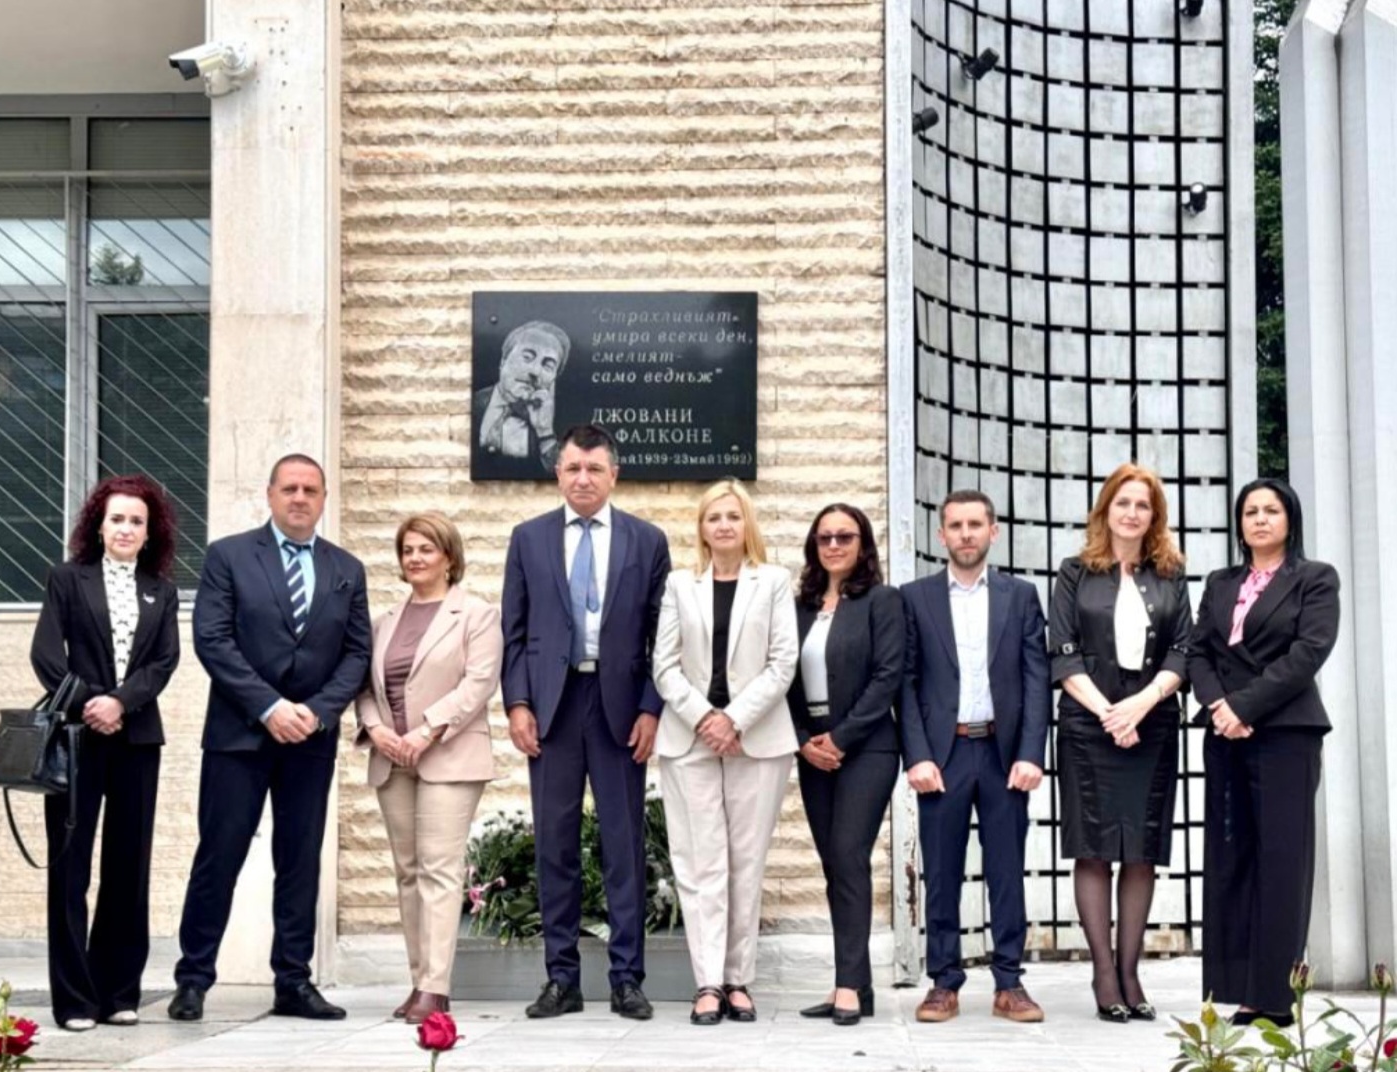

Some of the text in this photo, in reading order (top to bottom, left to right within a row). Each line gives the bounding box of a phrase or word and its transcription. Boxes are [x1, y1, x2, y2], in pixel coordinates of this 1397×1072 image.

[591, 328, 753, 346] умира всеки ден,
[591, 371, 637, 383] само
[591, 408, 693, 425] ДЖОВАНИ
[615, 428, 712, 444] ФАЛКОНЕ
